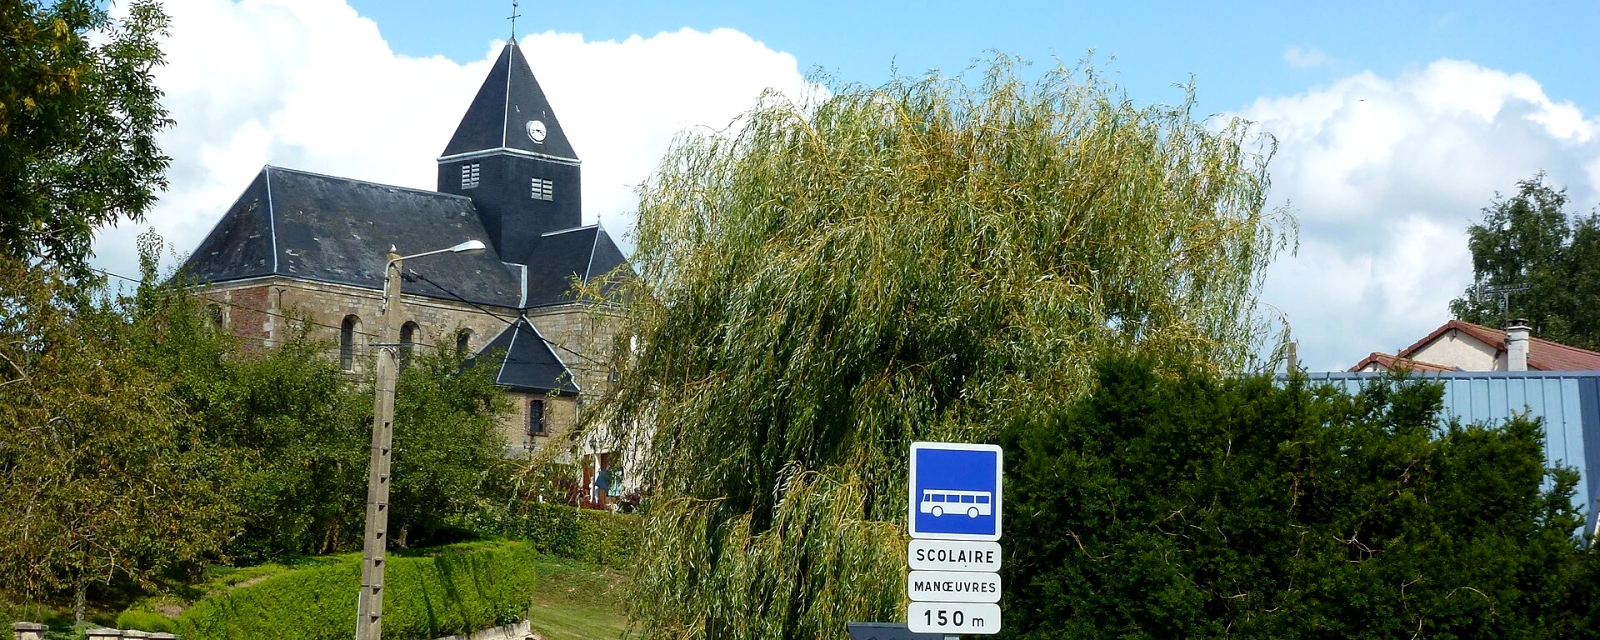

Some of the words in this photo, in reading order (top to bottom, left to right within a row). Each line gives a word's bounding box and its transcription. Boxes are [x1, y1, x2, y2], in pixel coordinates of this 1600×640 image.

[916, 548, 994, 564] SCOLAIRE
[914, 581, 996, 593] MANŒUVRES
[924, 609, 964, 627] 150
[972, 617, 984, 627] m
